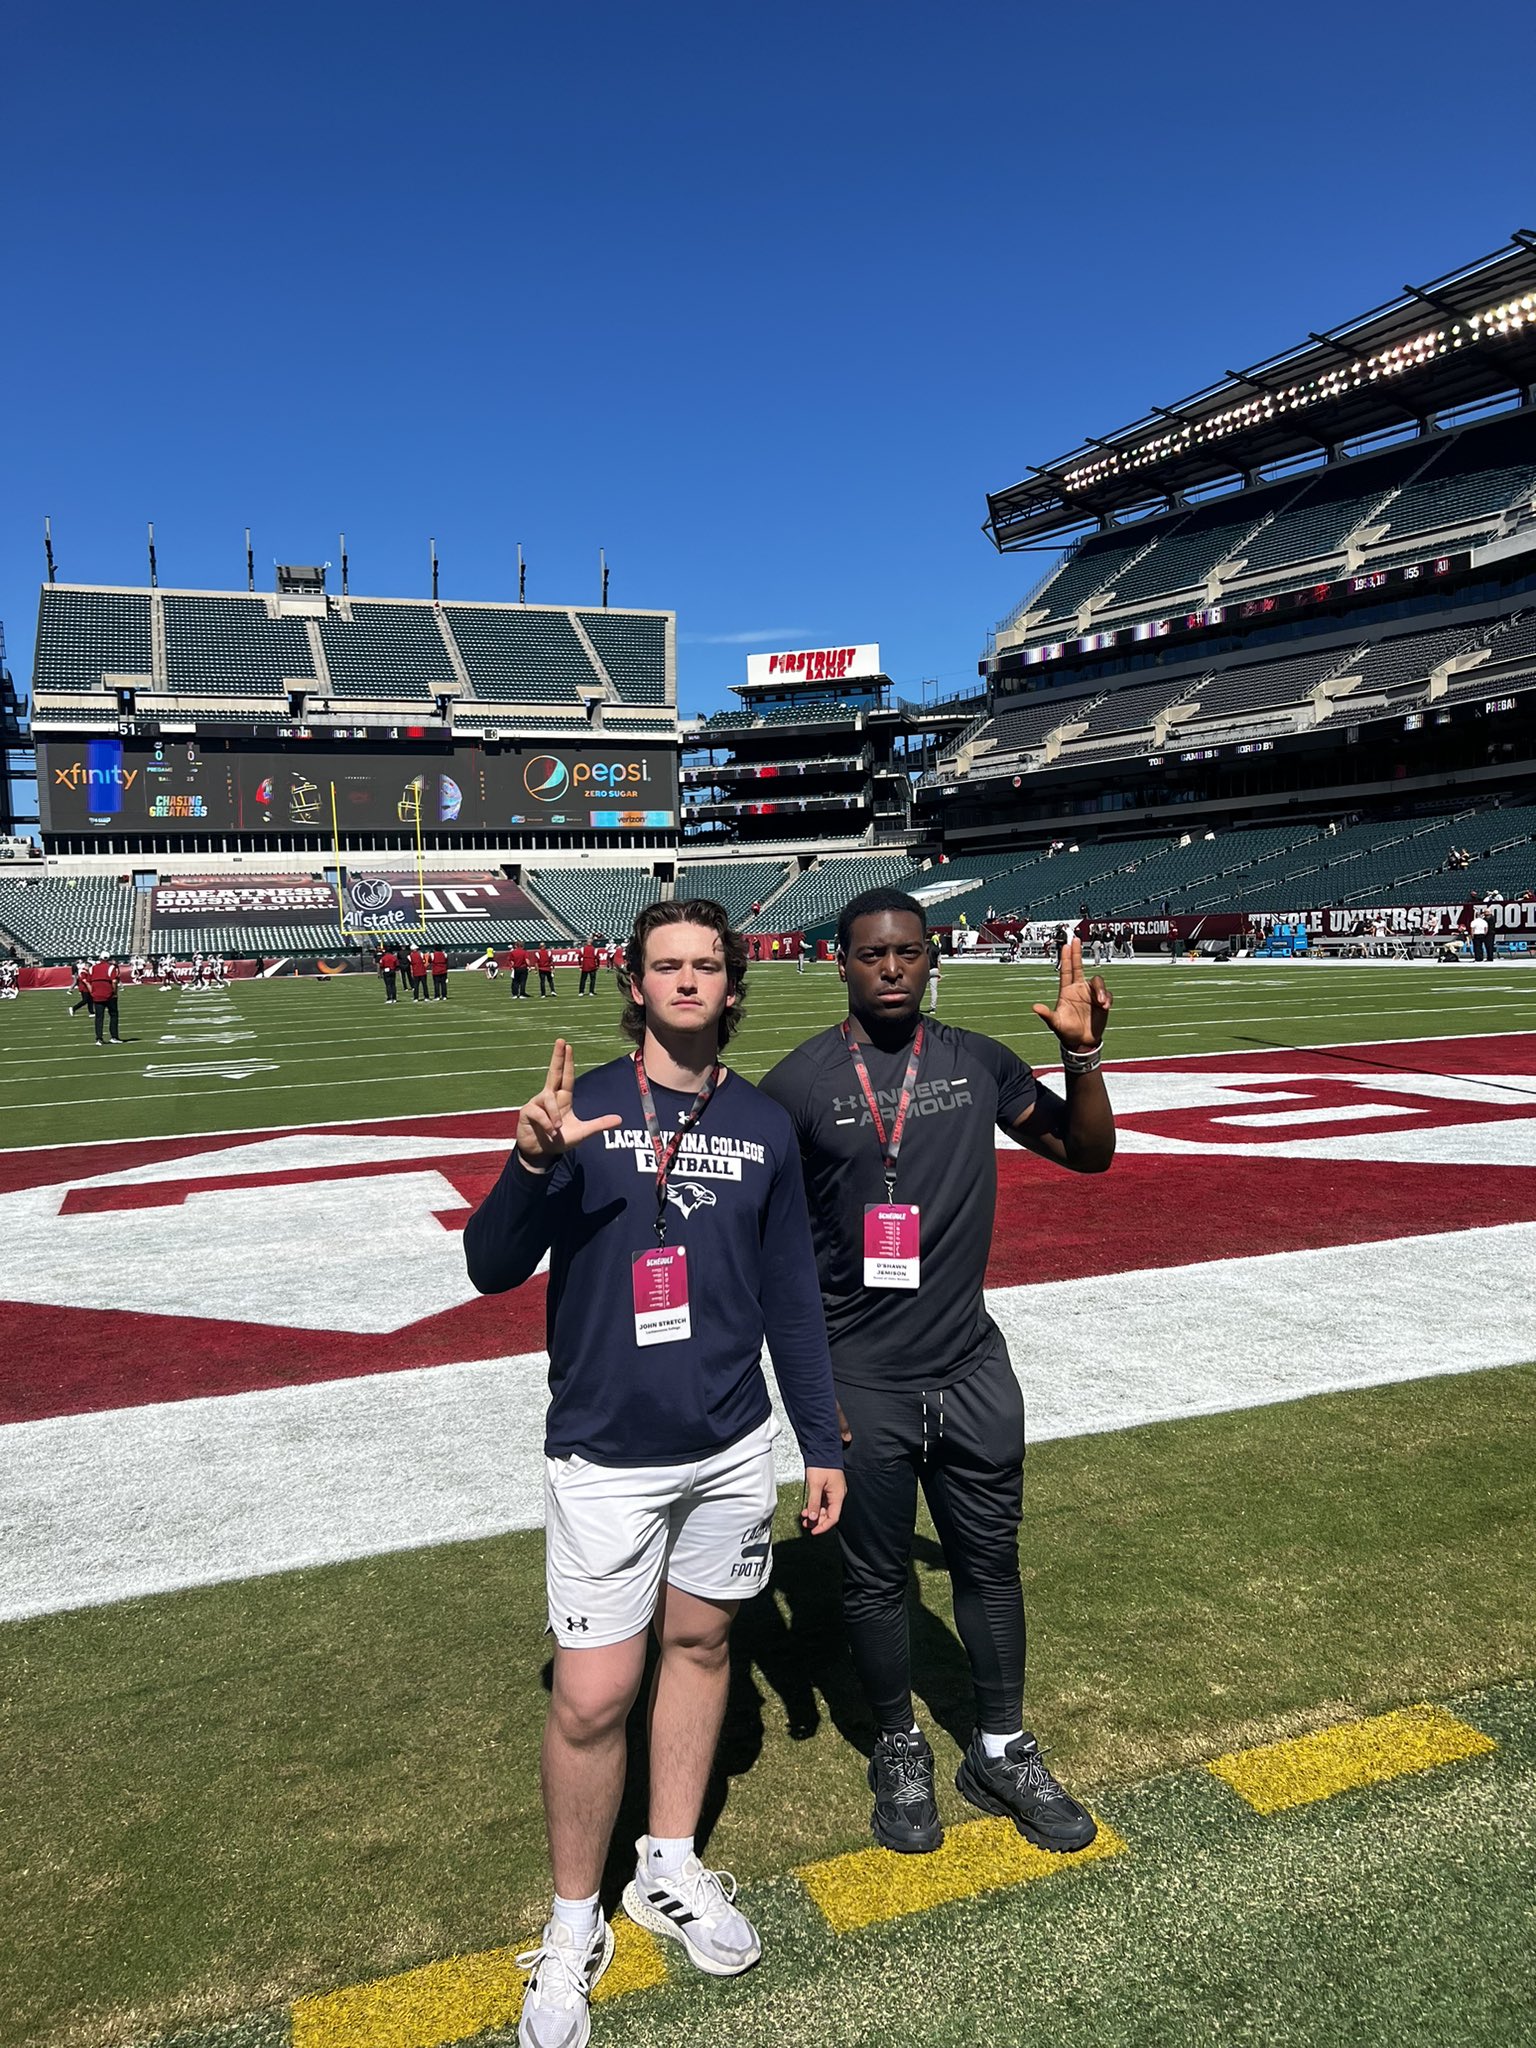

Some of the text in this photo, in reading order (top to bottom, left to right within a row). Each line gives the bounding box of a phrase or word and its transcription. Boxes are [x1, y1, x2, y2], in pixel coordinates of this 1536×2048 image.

[805, 666, 846, 681] BANK
[155, 750, 195, 761] 0 0
[55, 762, 138, 790] xfinity
[573, 758, 647, 787] pepsi
[584, 790, 638, 798] ZERO SUGAR
[155, 795, 202, 806] CHASING
[149, 806, 208, 817] GREATNESS
[617, 813, 646, 824] verizon
[156, 887, 331, 899] GREATNESS
[156, 894, 334, 906] DOESN'T QUIT.
[156, 903, 338, 913] TEMPLE FOOTBALL
[343, 910, 405, 927] Allstate
[710, 1135, 765, 1164] COLLEGE
[646, 1256, 674, 1267] SCHEDULE
[639, 1317, 687, 1330] JOHN STRETCH
